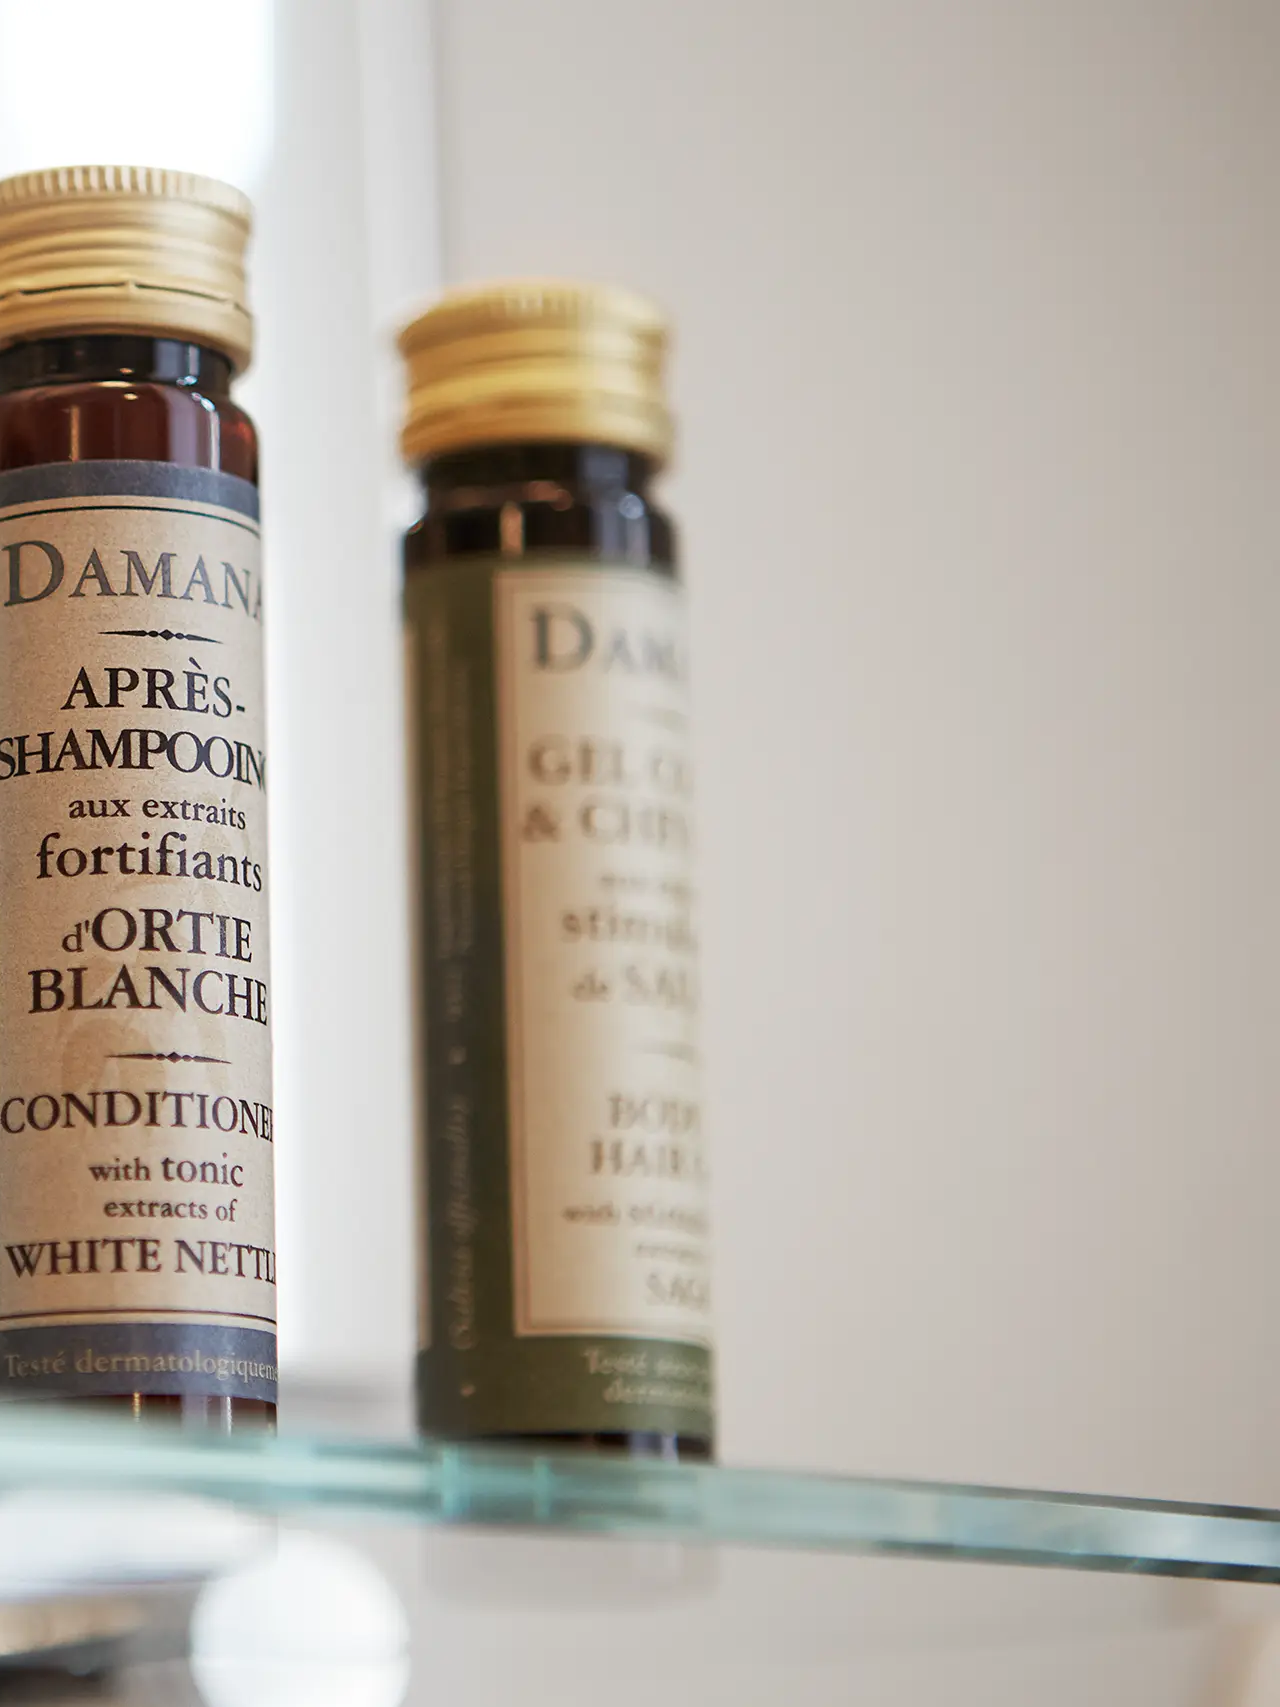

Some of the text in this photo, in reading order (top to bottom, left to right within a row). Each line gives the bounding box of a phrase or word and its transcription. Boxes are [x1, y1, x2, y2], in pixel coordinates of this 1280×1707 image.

[60, 656, 246, 718] APRÈS-
[68, 797, 246, 830] aux extraits
[36, 831, 263, 892] fortifiants
[61, 907, 253, 964] d'ORTIE
[27, 963, 268, 1026] BLANCHE
[89, 1152, 244, 1188] with tonic
[103, 1199, 239, 1223] extracts of
[5, 1238, 163, 1278] WHITE
[4, 1350, 67, 1379] Testé
